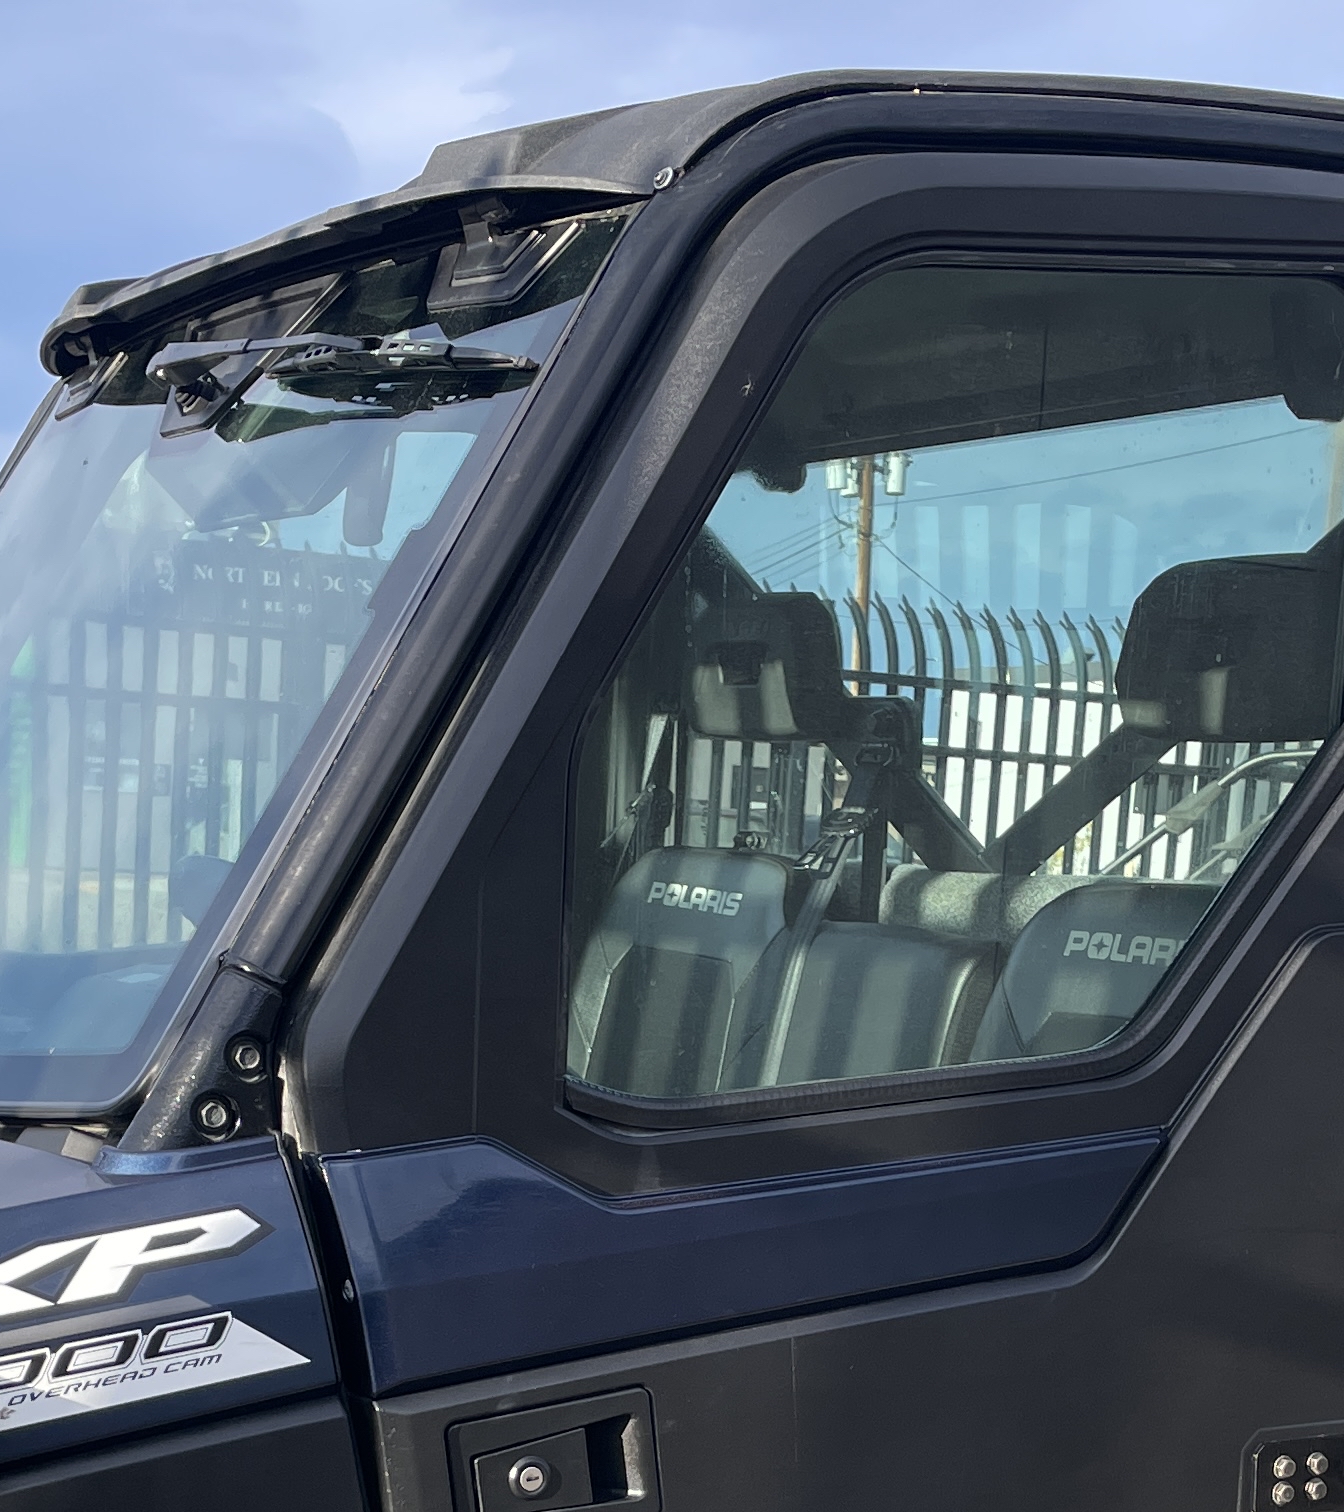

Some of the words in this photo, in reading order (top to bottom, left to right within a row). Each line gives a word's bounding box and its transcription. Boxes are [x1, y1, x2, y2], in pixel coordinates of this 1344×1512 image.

[647, 881, 743, 916] POLARIS
[1063, 930, 1188, 968] POLAR
[7, 1367, 157, 1408] OVERHEAD
[163, 1353, 224, 1375] CAM
